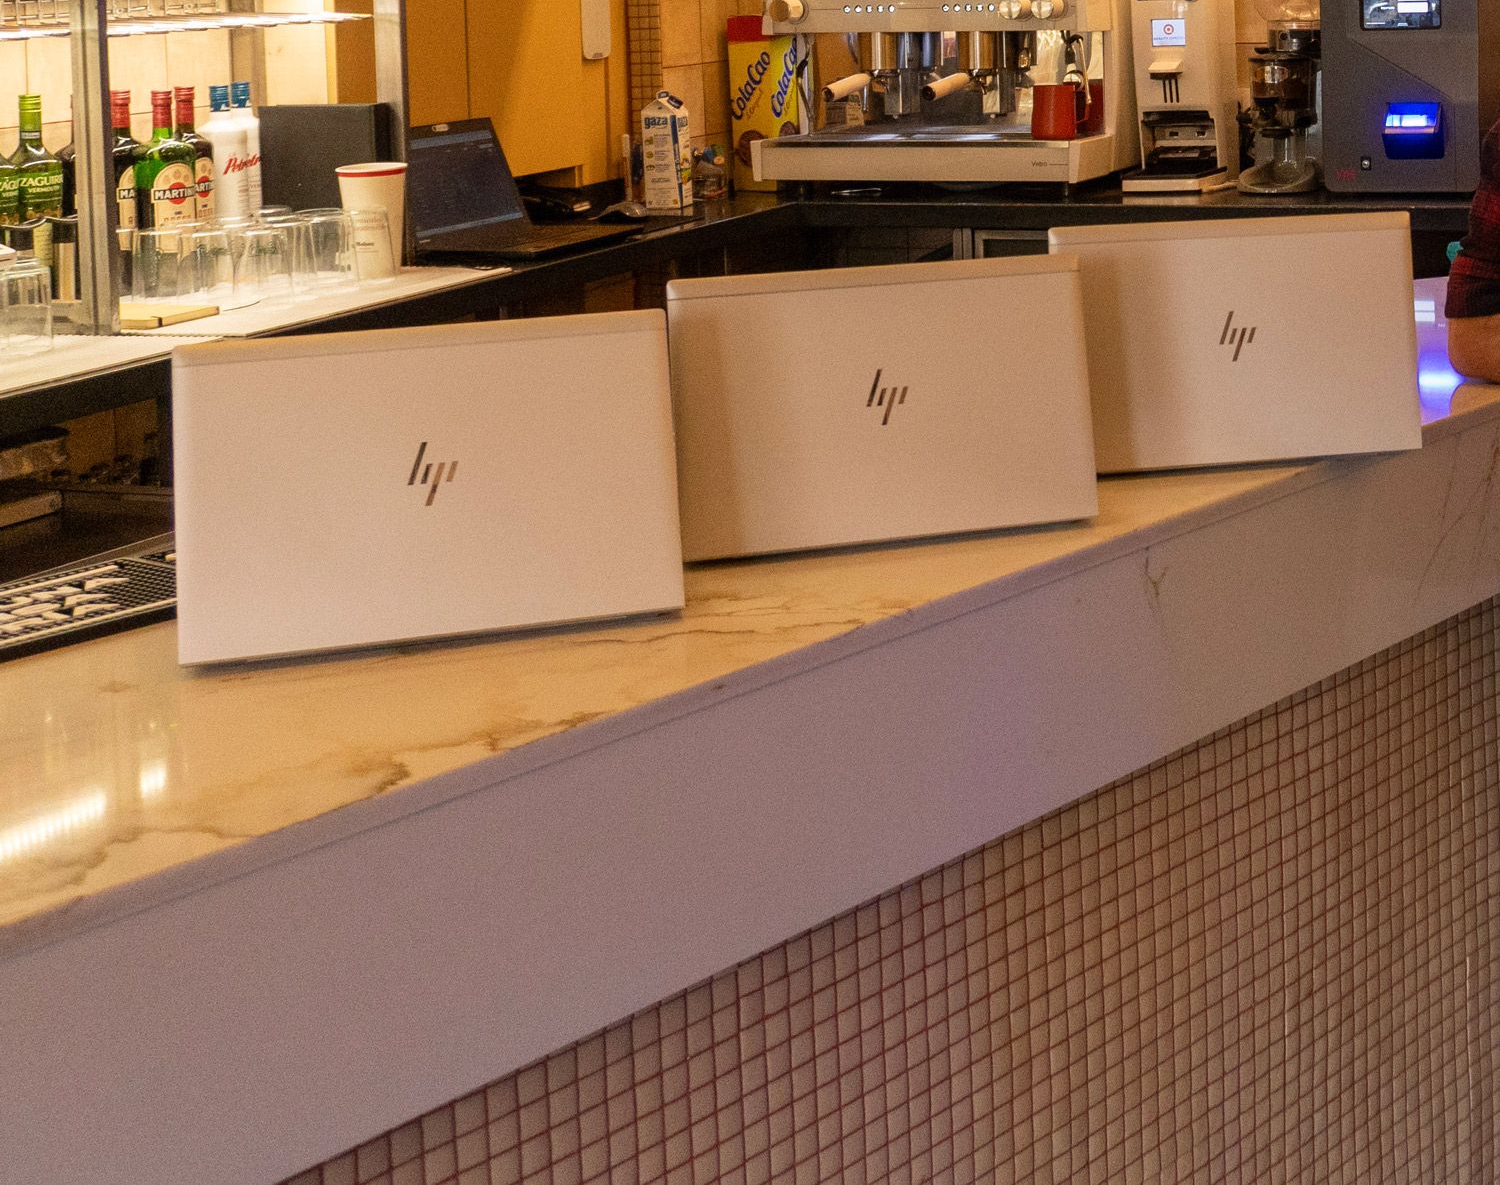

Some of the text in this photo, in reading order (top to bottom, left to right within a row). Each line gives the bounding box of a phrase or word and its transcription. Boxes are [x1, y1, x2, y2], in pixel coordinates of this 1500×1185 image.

[730, 51, 771, 121] ColaCao
[644, 116, 668, 130] gaza
[1219, 310, 1257, 362] hp
[866, 368, 909, 426] hp
[407, 441, 459, 507] hp
